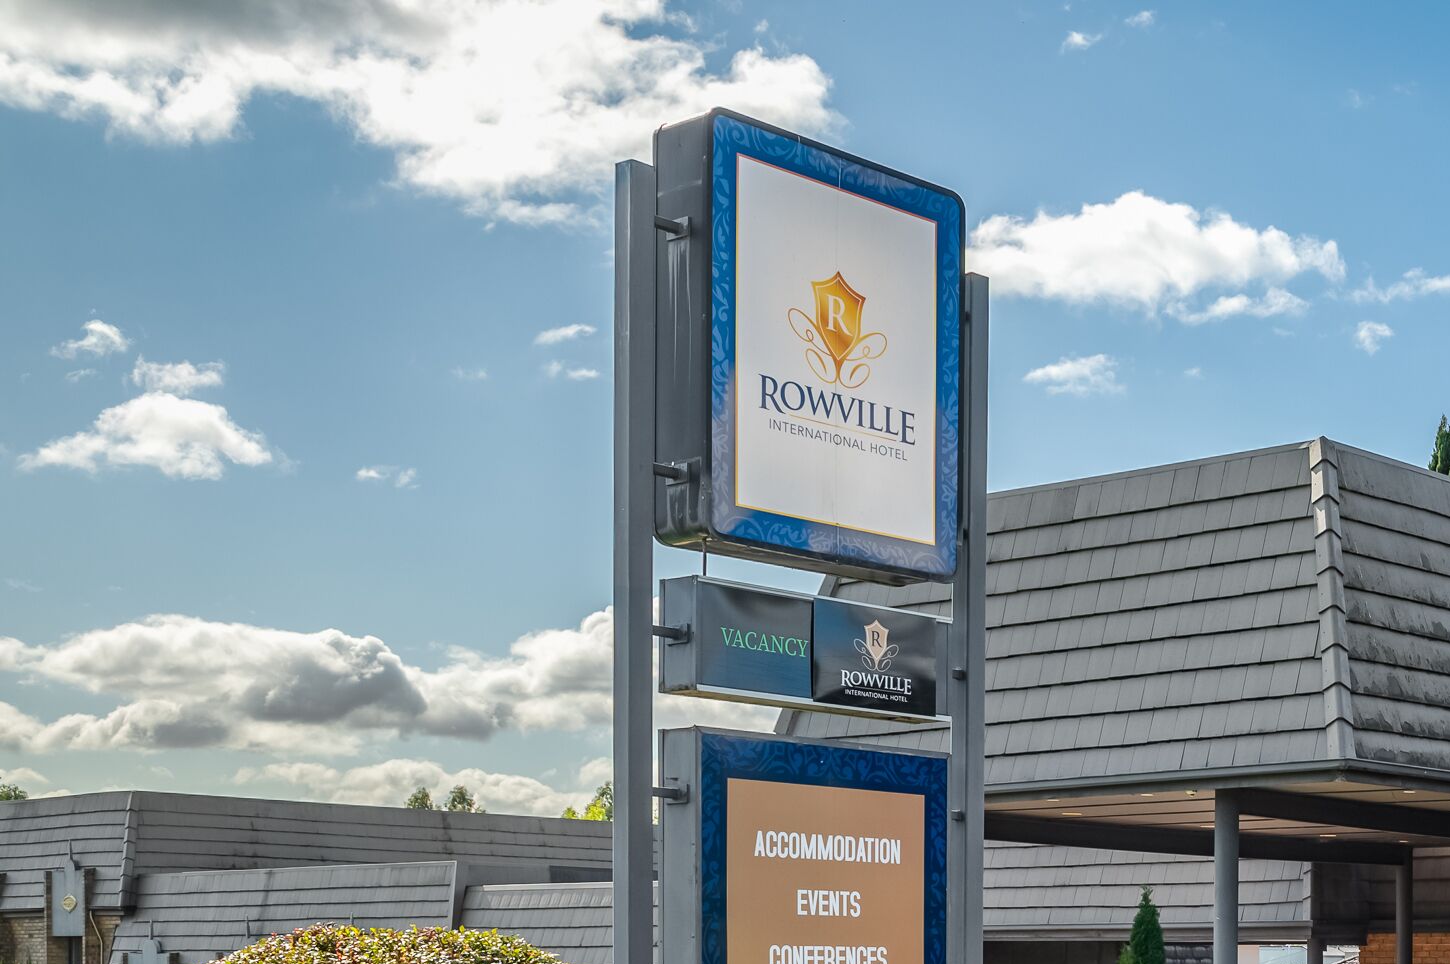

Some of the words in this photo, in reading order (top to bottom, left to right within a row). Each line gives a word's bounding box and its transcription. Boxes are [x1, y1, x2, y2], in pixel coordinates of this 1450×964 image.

[826, 294, 853, 336] R
[758, 373, 916, 446] ROWVILLE
[768, 418, 867, 452] INTERNATIONAL
[869, 443, 908, 461] HOTEL
[720, 626, 809, 657] VACANCY
[871, 630, 882, 648] R
[840, 669, 912, 695] ROWVILLE
[844, 689, 889, 700] INTERNATIONAL
[890, 695, 908, 703] HOTEL
[754, 830, 901, 865] ACCOMMODATION
[796, 889, 861, 918] EVENTS
